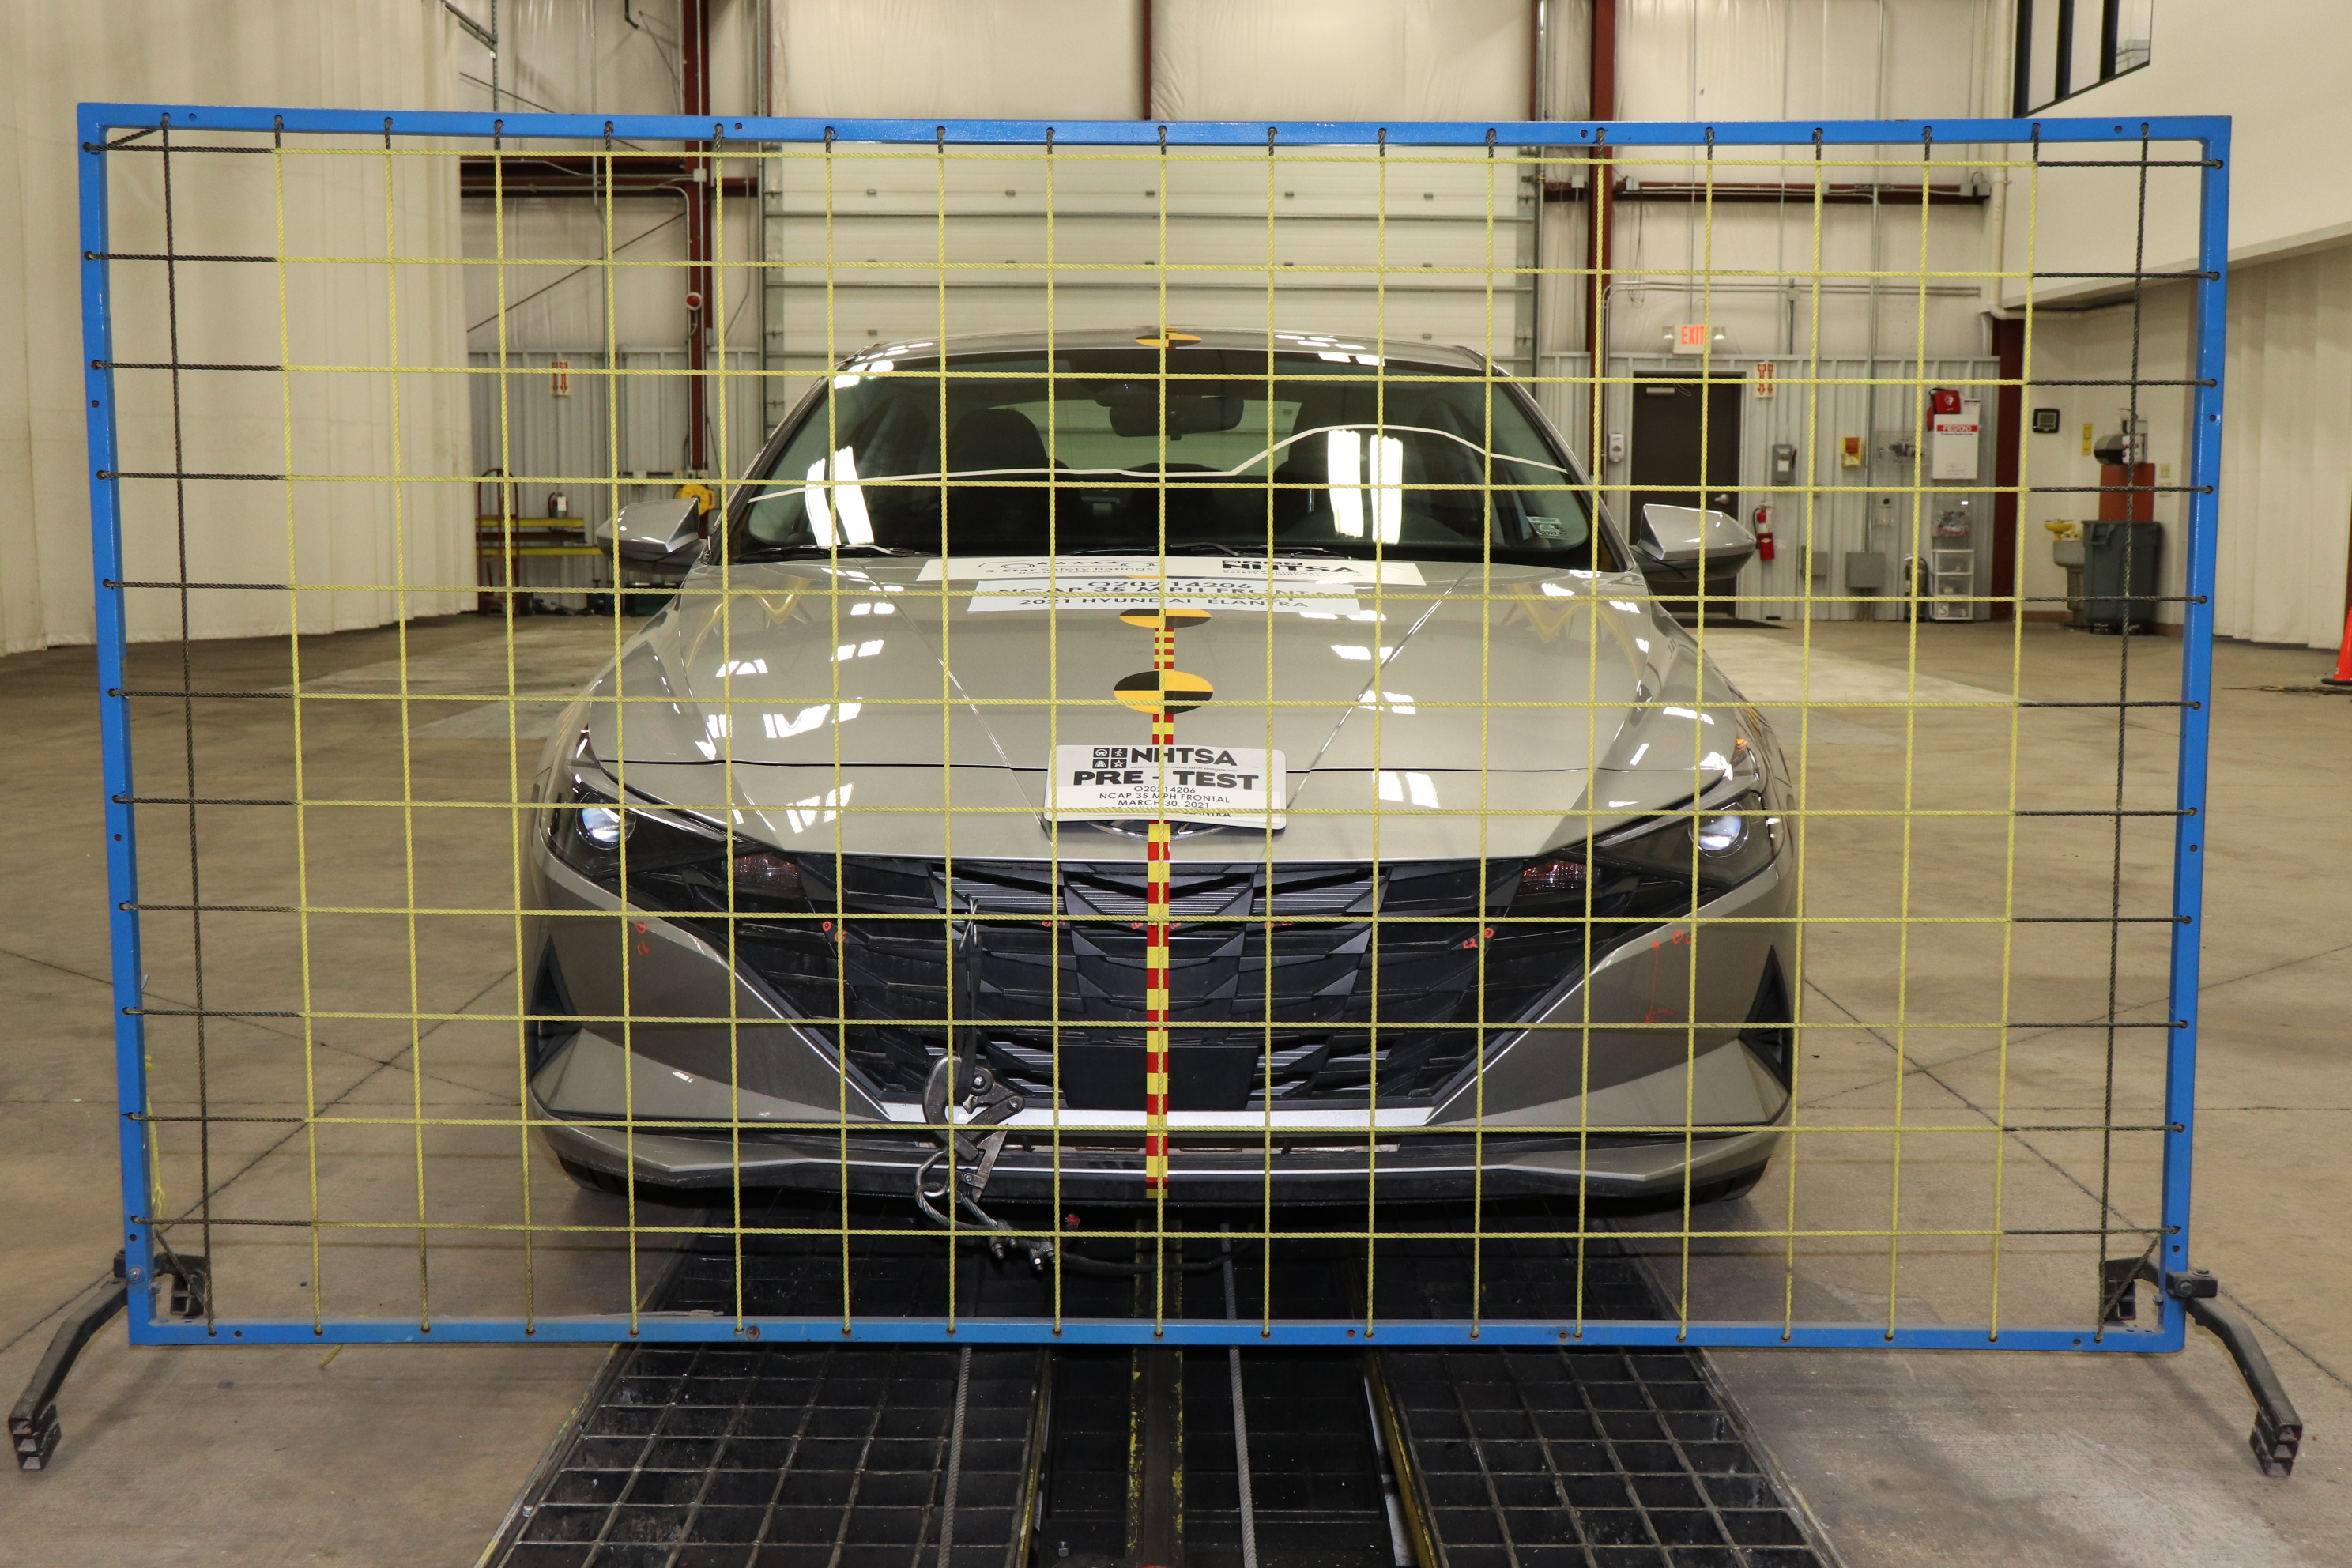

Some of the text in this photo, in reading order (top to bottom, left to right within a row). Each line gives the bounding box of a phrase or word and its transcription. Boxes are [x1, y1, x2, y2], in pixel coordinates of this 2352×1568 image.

[1681, 326, 1706, 345] EXIT
[1223, 564, 1357, 572] NHTSA
[1131, 748, 1238, 766] NHTSA
[1073, 771, 1144, 786] PRE
[1172, 771, 1259, 790] TEST
[1181, 794, 1230, 803] FRONTAL
